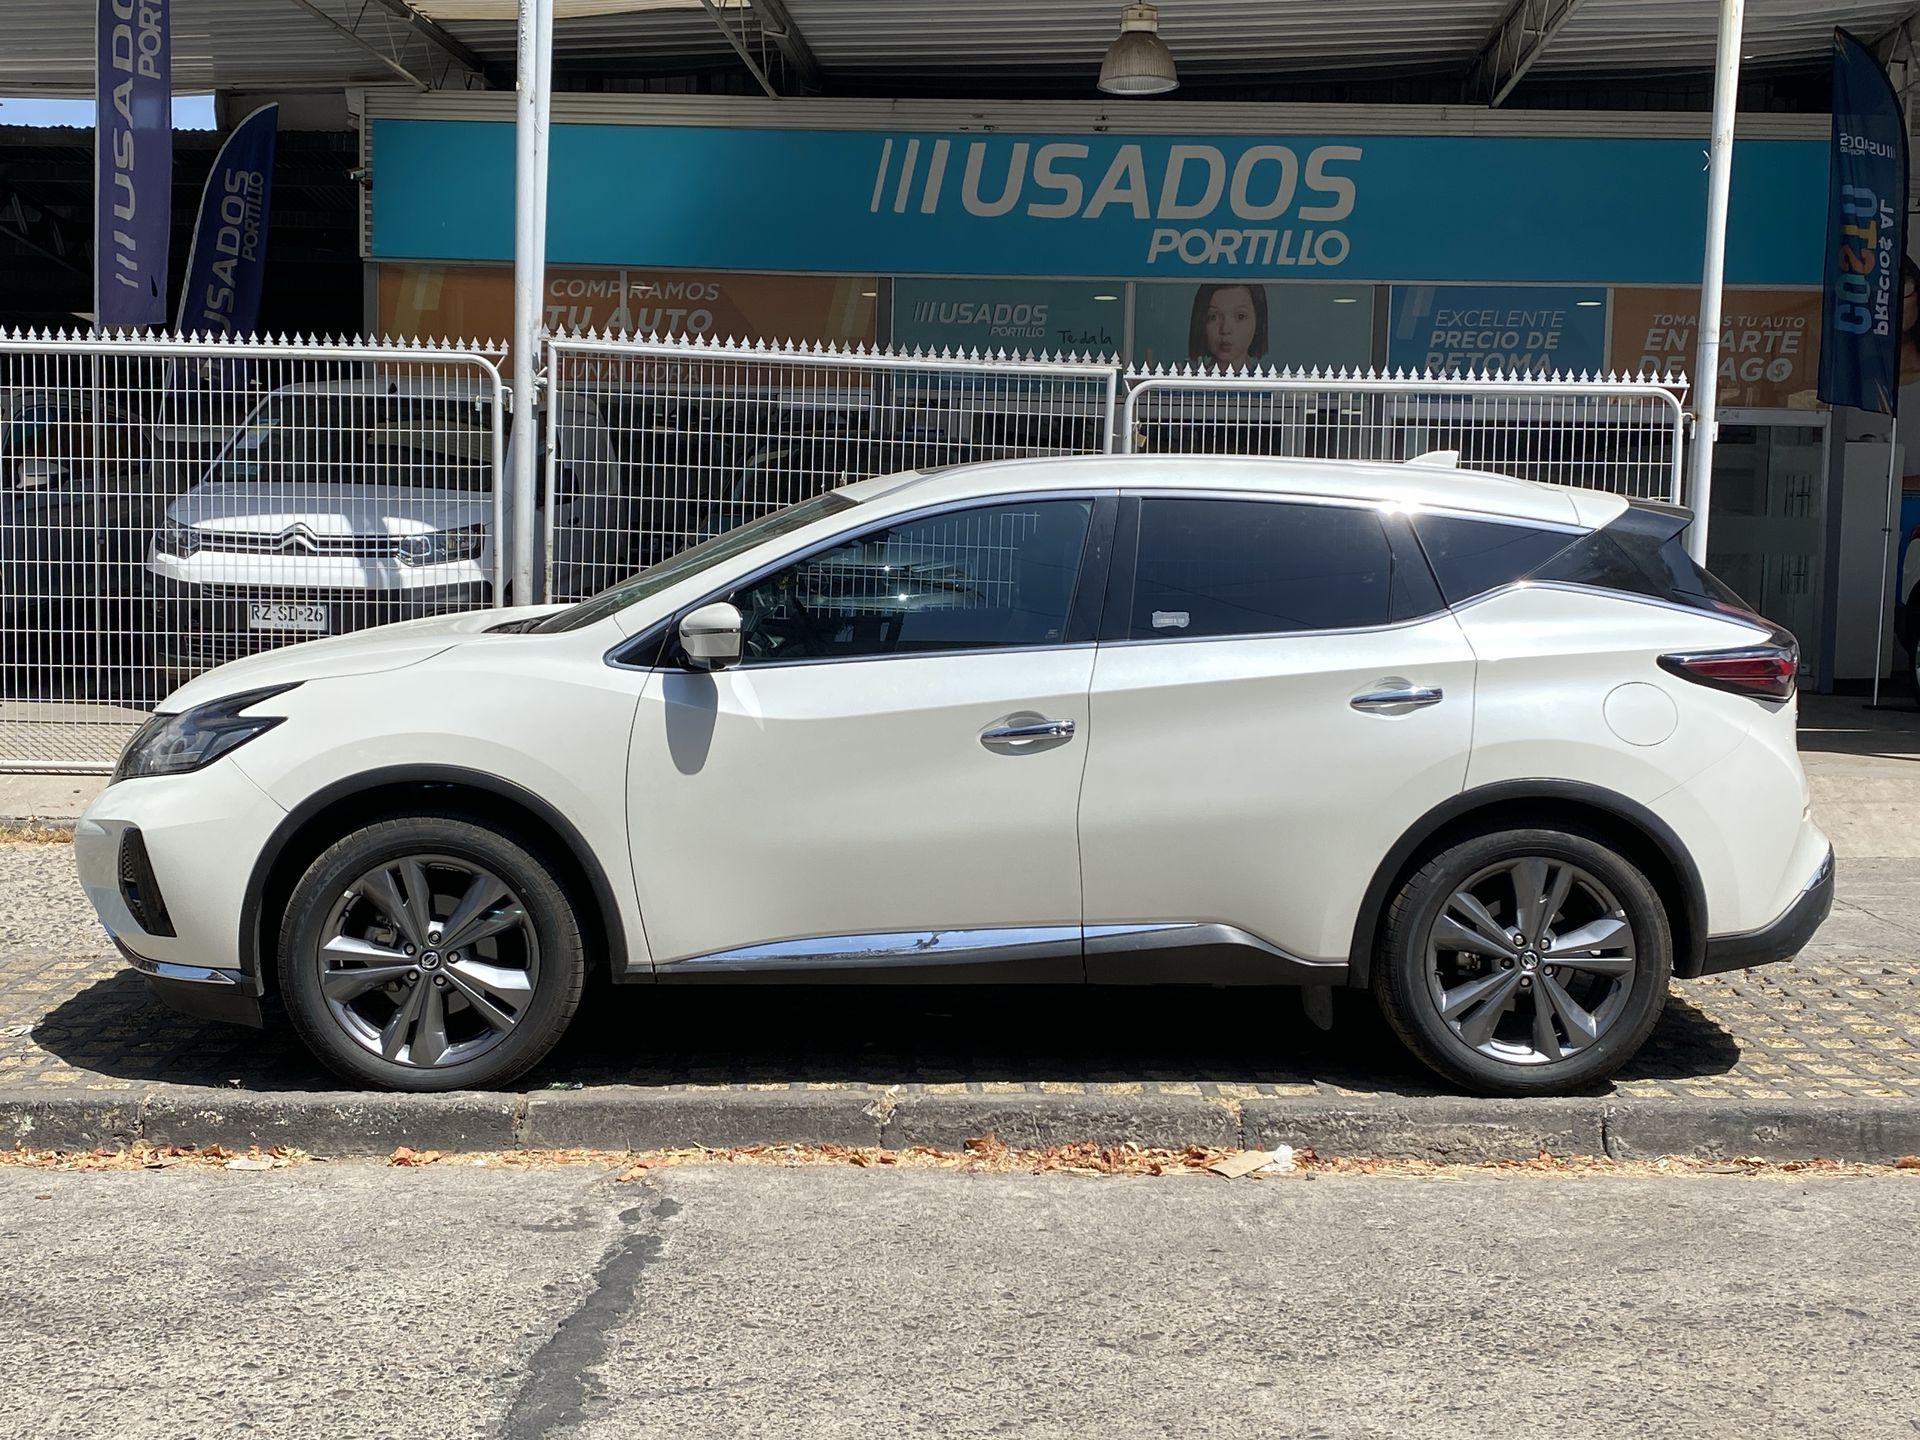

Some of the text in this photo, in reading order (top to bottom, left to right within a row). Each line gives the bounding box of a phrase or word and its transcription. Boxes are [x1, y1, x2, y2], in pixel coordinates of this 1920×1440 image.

[961, 142, 1362, 221] USADOS
[242, 171, 264, 262] PORTILLO
[1147, 228, 1350, 266] PORTILLO
[551, 278, 720, 301] COMPRAMOS
[546, 305, 713, 334] TU AUTO
[938, 302, 1048, 326] USADOS
[1435, 310, 1566, 327] EXCELENTE
[1653, 314, 1806, 328] TOMAS TU AUTO
[989, 326, 1045, 338] PORTILLO
[1057, 330, 1076, 345] Te
[1429, 330, 1561, 349] PRECIO DE
[1644, 328, 1802, 353] EN ARTE
[1425, 352, 1551, 375] RETOMA
[1636, 355, 1793, 382] DE AGO
